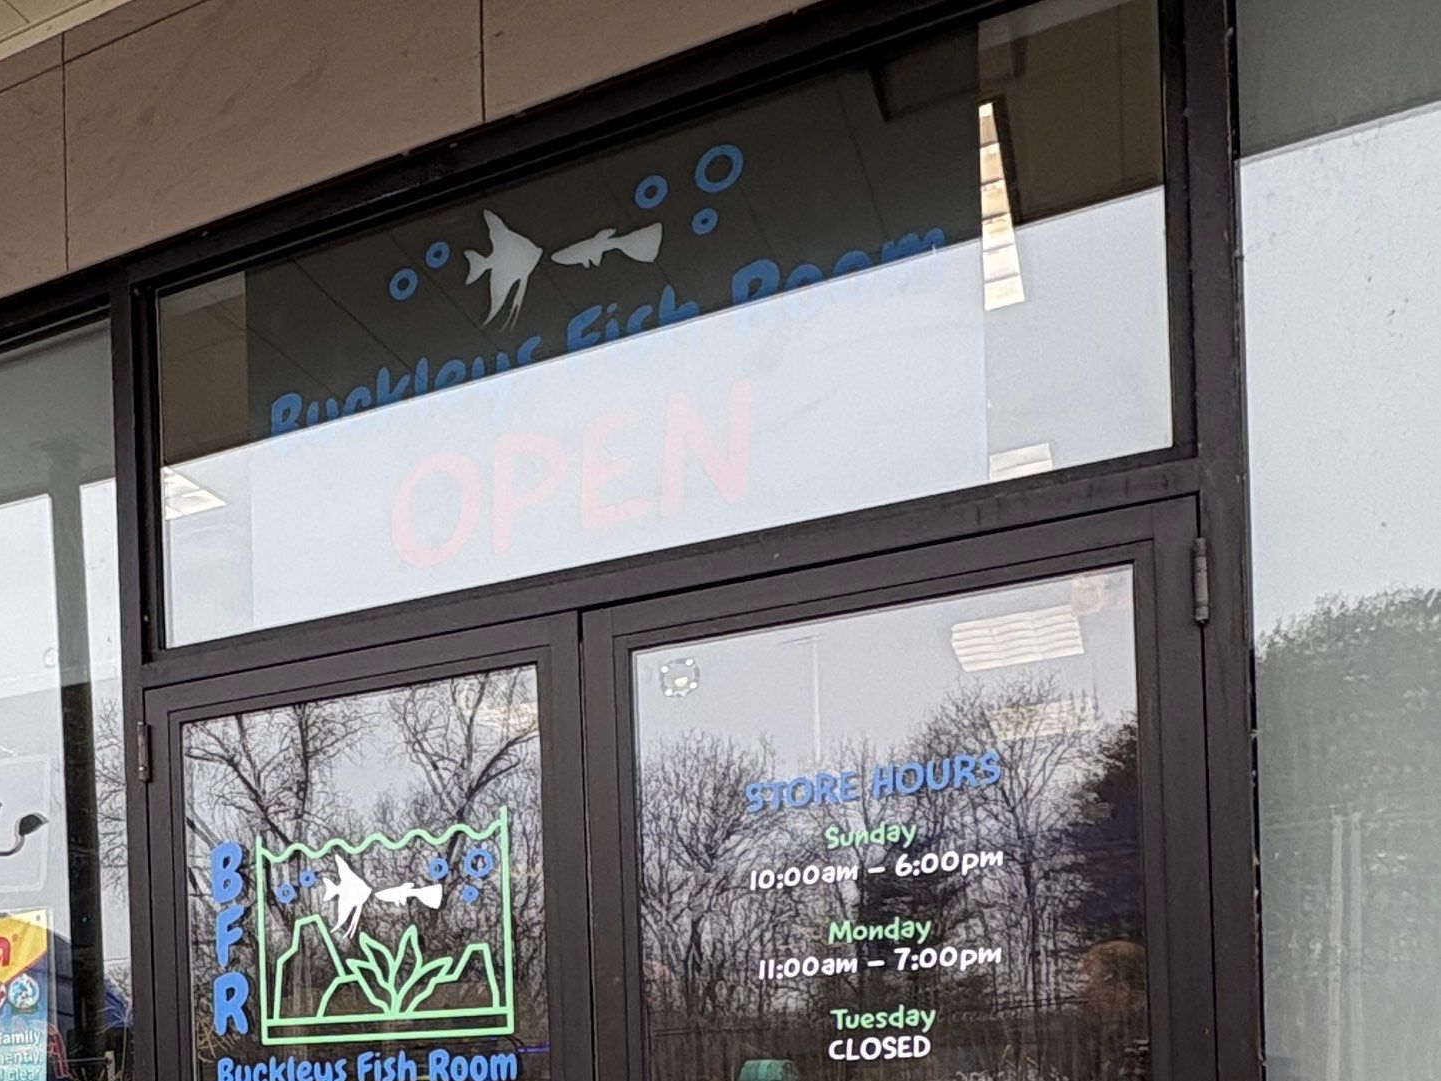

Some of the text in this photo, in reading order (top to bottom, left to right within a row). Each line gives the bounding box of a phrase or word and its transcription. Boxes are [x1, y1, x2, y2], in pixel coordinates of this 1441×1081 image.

[270, 334, 542, 446] Buckleys
[567, 284, 700, 364] Fish
[390, 376, 752, 569] OPEN
[745, 749, 1004, 814] STORE HOURS
[824, 821, 918, 850] Sunday
[749, 864, 859, 891] 10:00am
[895, 851, 1005, 882] 6:00pm
[827, 915, 932, 945] Monday
[758, 953, 859, 981] 11:00am
[894, 947, 1004, 979] 7:00pm
[830, 1006, 937, 1034] Tuesday
[827, 1036, 932, 1062] CLOSED
